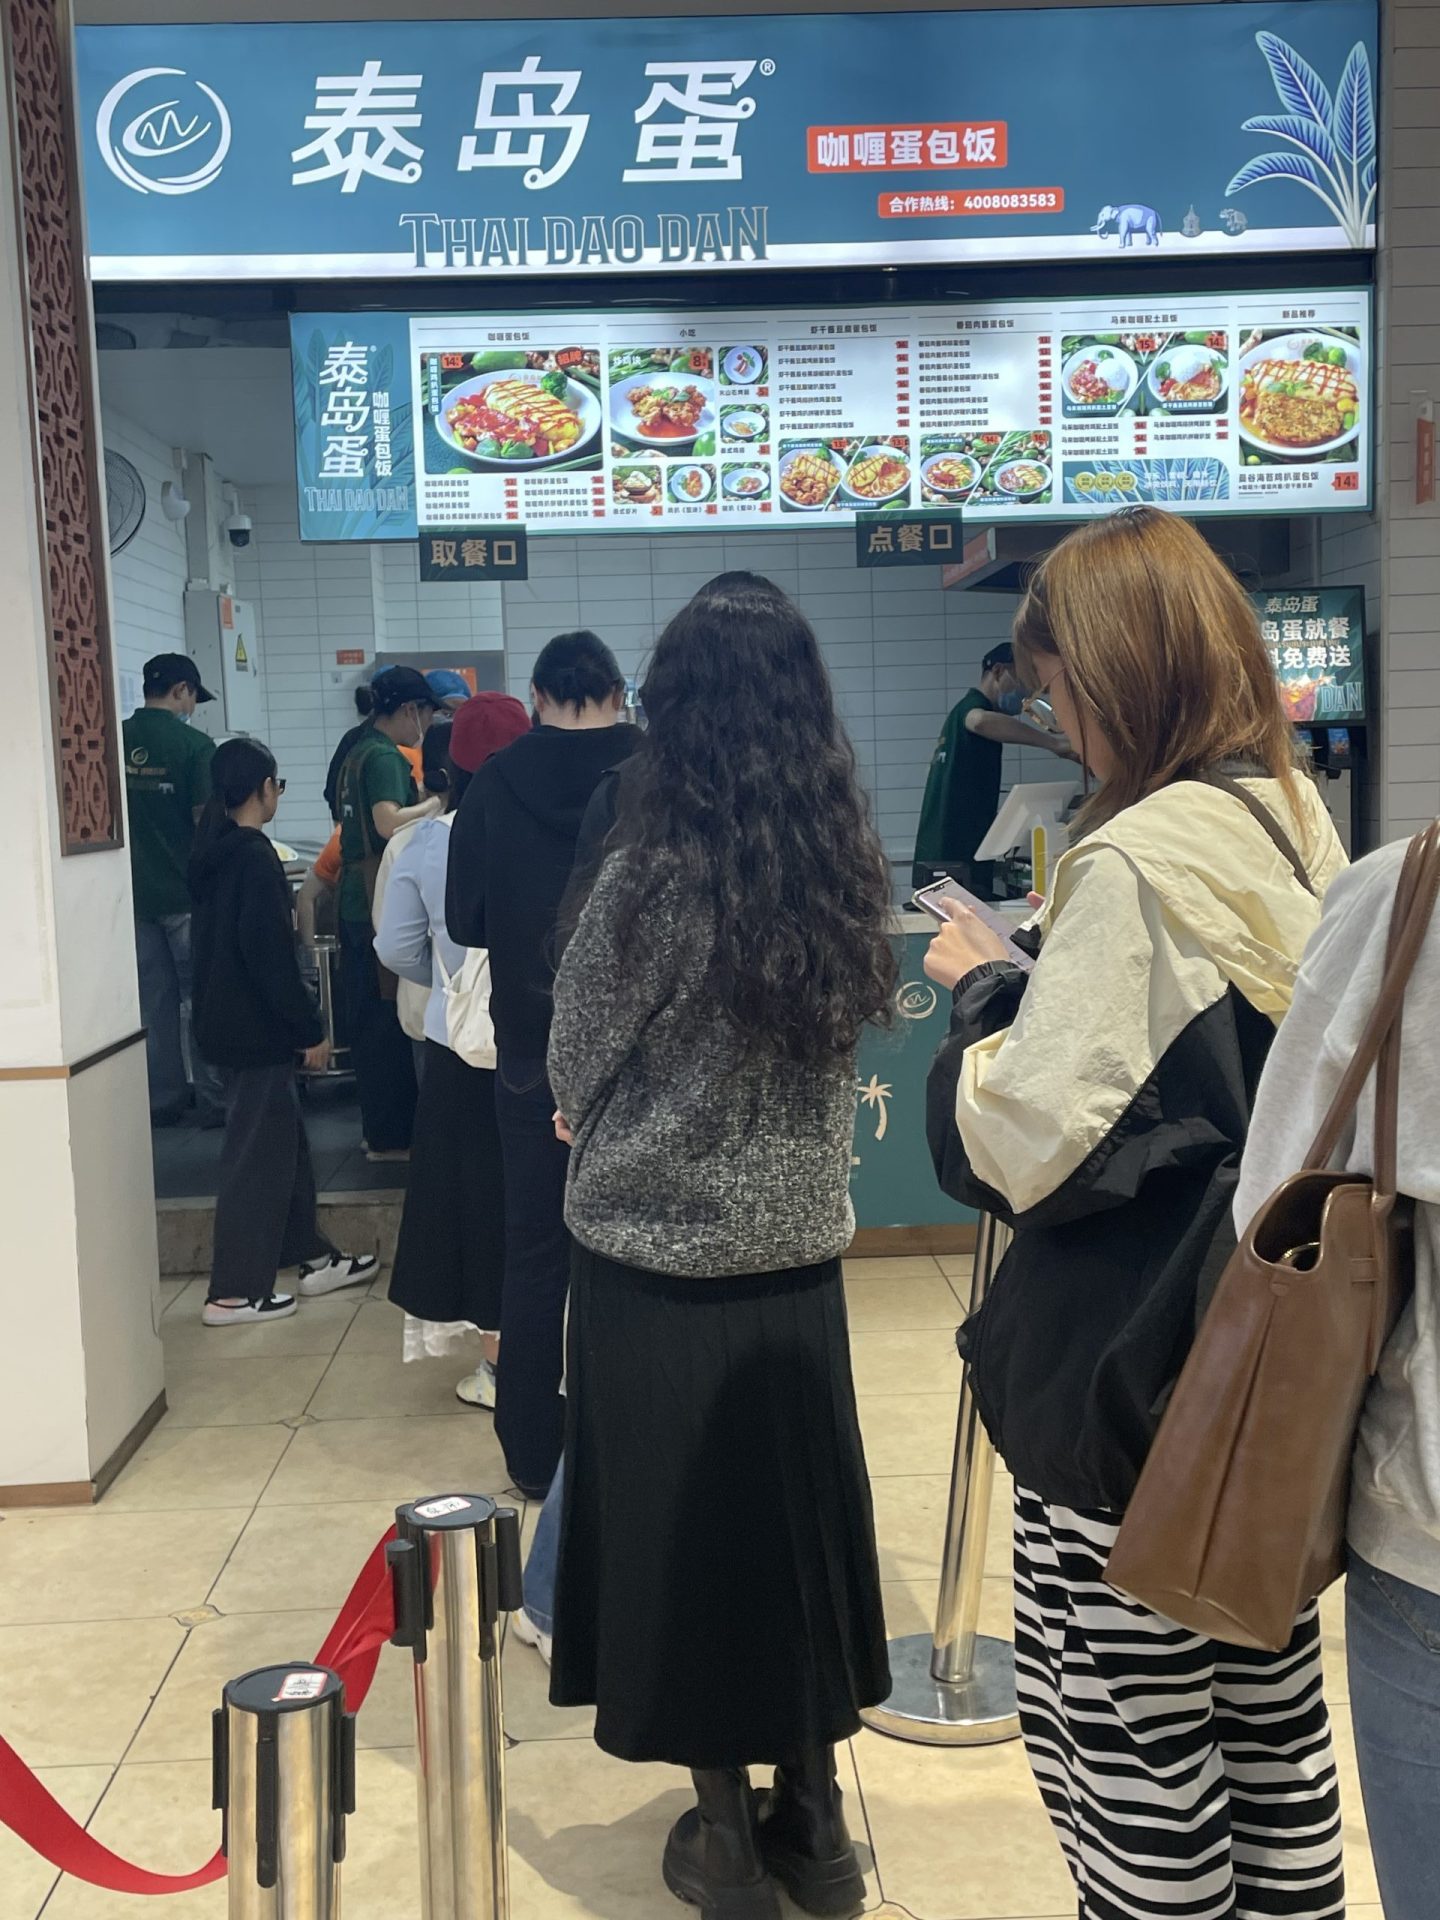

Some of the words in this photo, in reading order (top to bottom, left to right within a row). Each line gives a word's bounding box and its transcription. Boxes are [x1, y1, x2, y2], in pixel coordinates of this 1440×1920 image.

[291, 56, 758, 193] 泰岛蛋
[816, 127, 997, 168] 咖喱蛋包饭
[399, 213, 529, 268] THAI
[543, 214, 645, 267] DAO
[658, 206, 769, 264] DAN
[679, 328, 697, 338] 小吃
[318, 341, 370, 478] 泰岛蛋
[372, 391, 393, 477] 咖喱蛋包饭
[304, 486, 342, 512] THAI
[344, 488, 374, 512] DAO
[431, 539, 516, 567] 取餐口
[868, 524, 952, 553] 点餐口
[1265, 596, 1320, 614] 泰岛蛋
[1321, 682, 1362, 712] DAN
